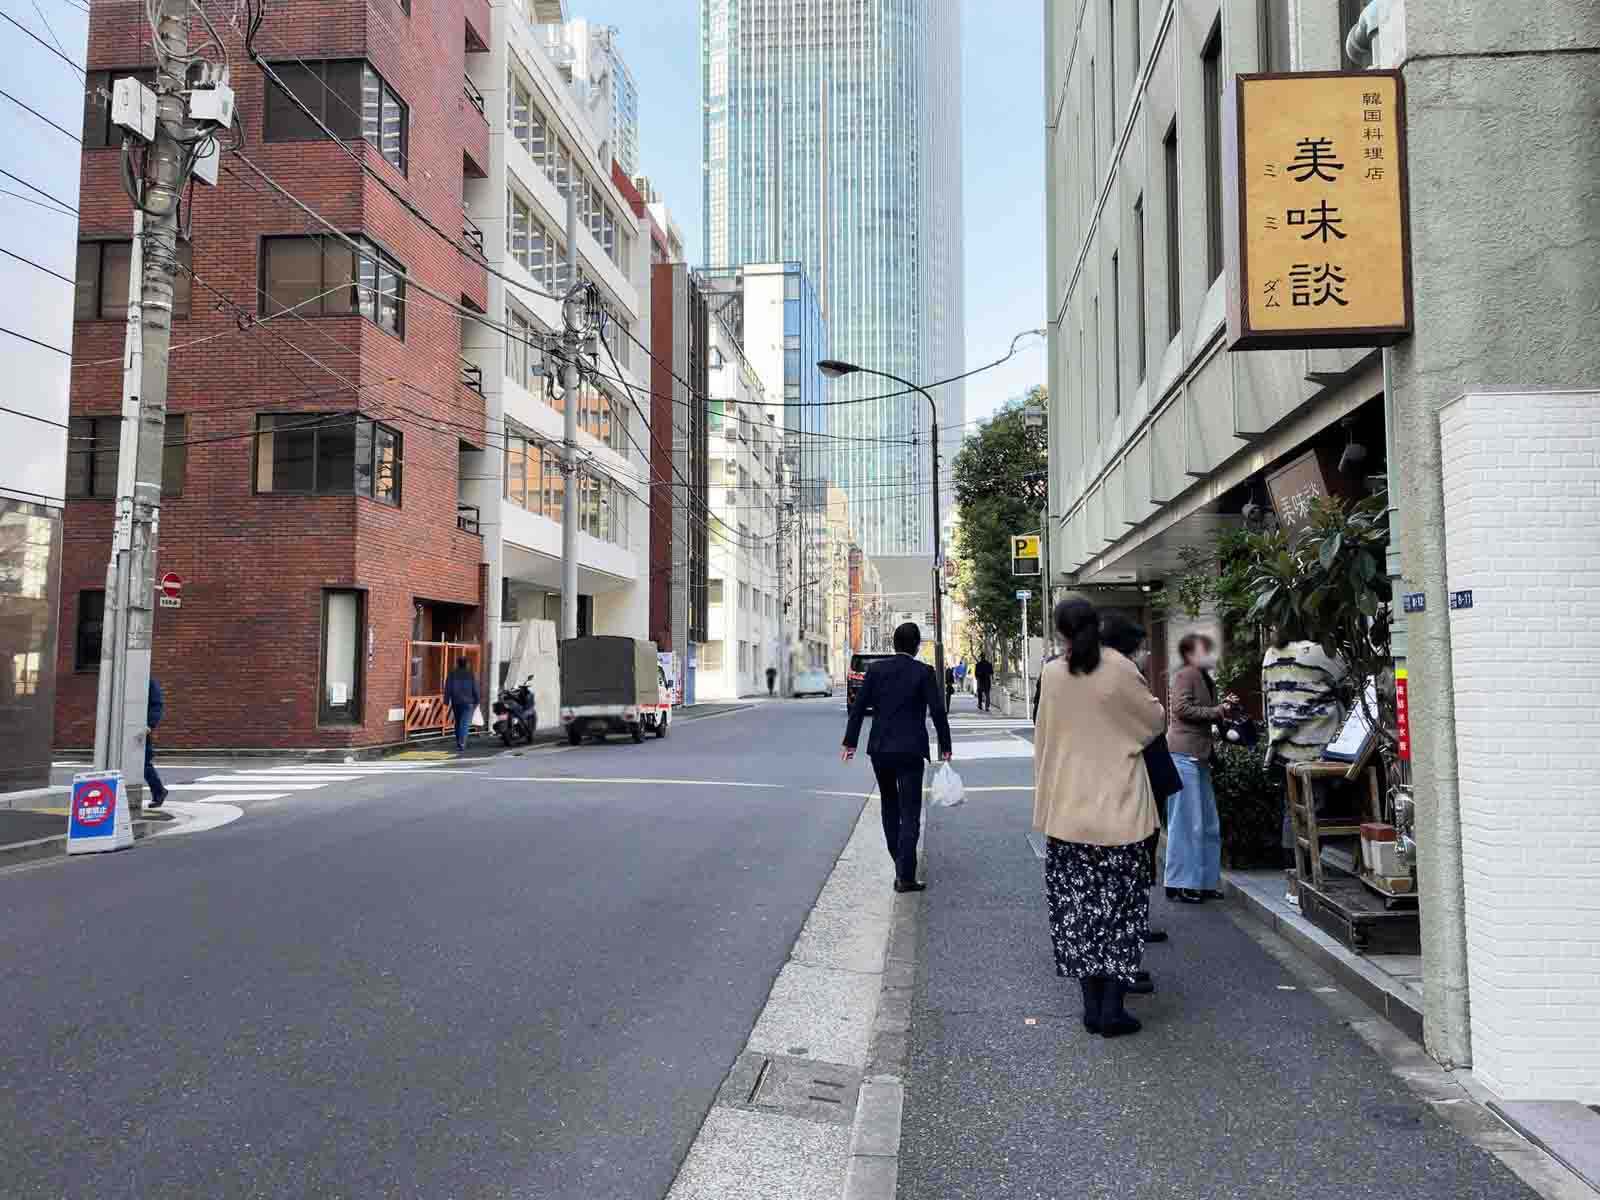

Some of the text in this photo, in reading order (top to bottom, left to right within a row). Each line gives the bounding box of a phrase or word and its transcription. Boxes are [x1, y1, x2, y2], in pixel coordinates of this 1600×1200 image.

[1362, 92, 1384, 181] 韓国料理店
[1286, 136, 1349, 307] 美味談
[1263, 279, 1281, 308] ダム
[1016, 539, 1028, 557] P
